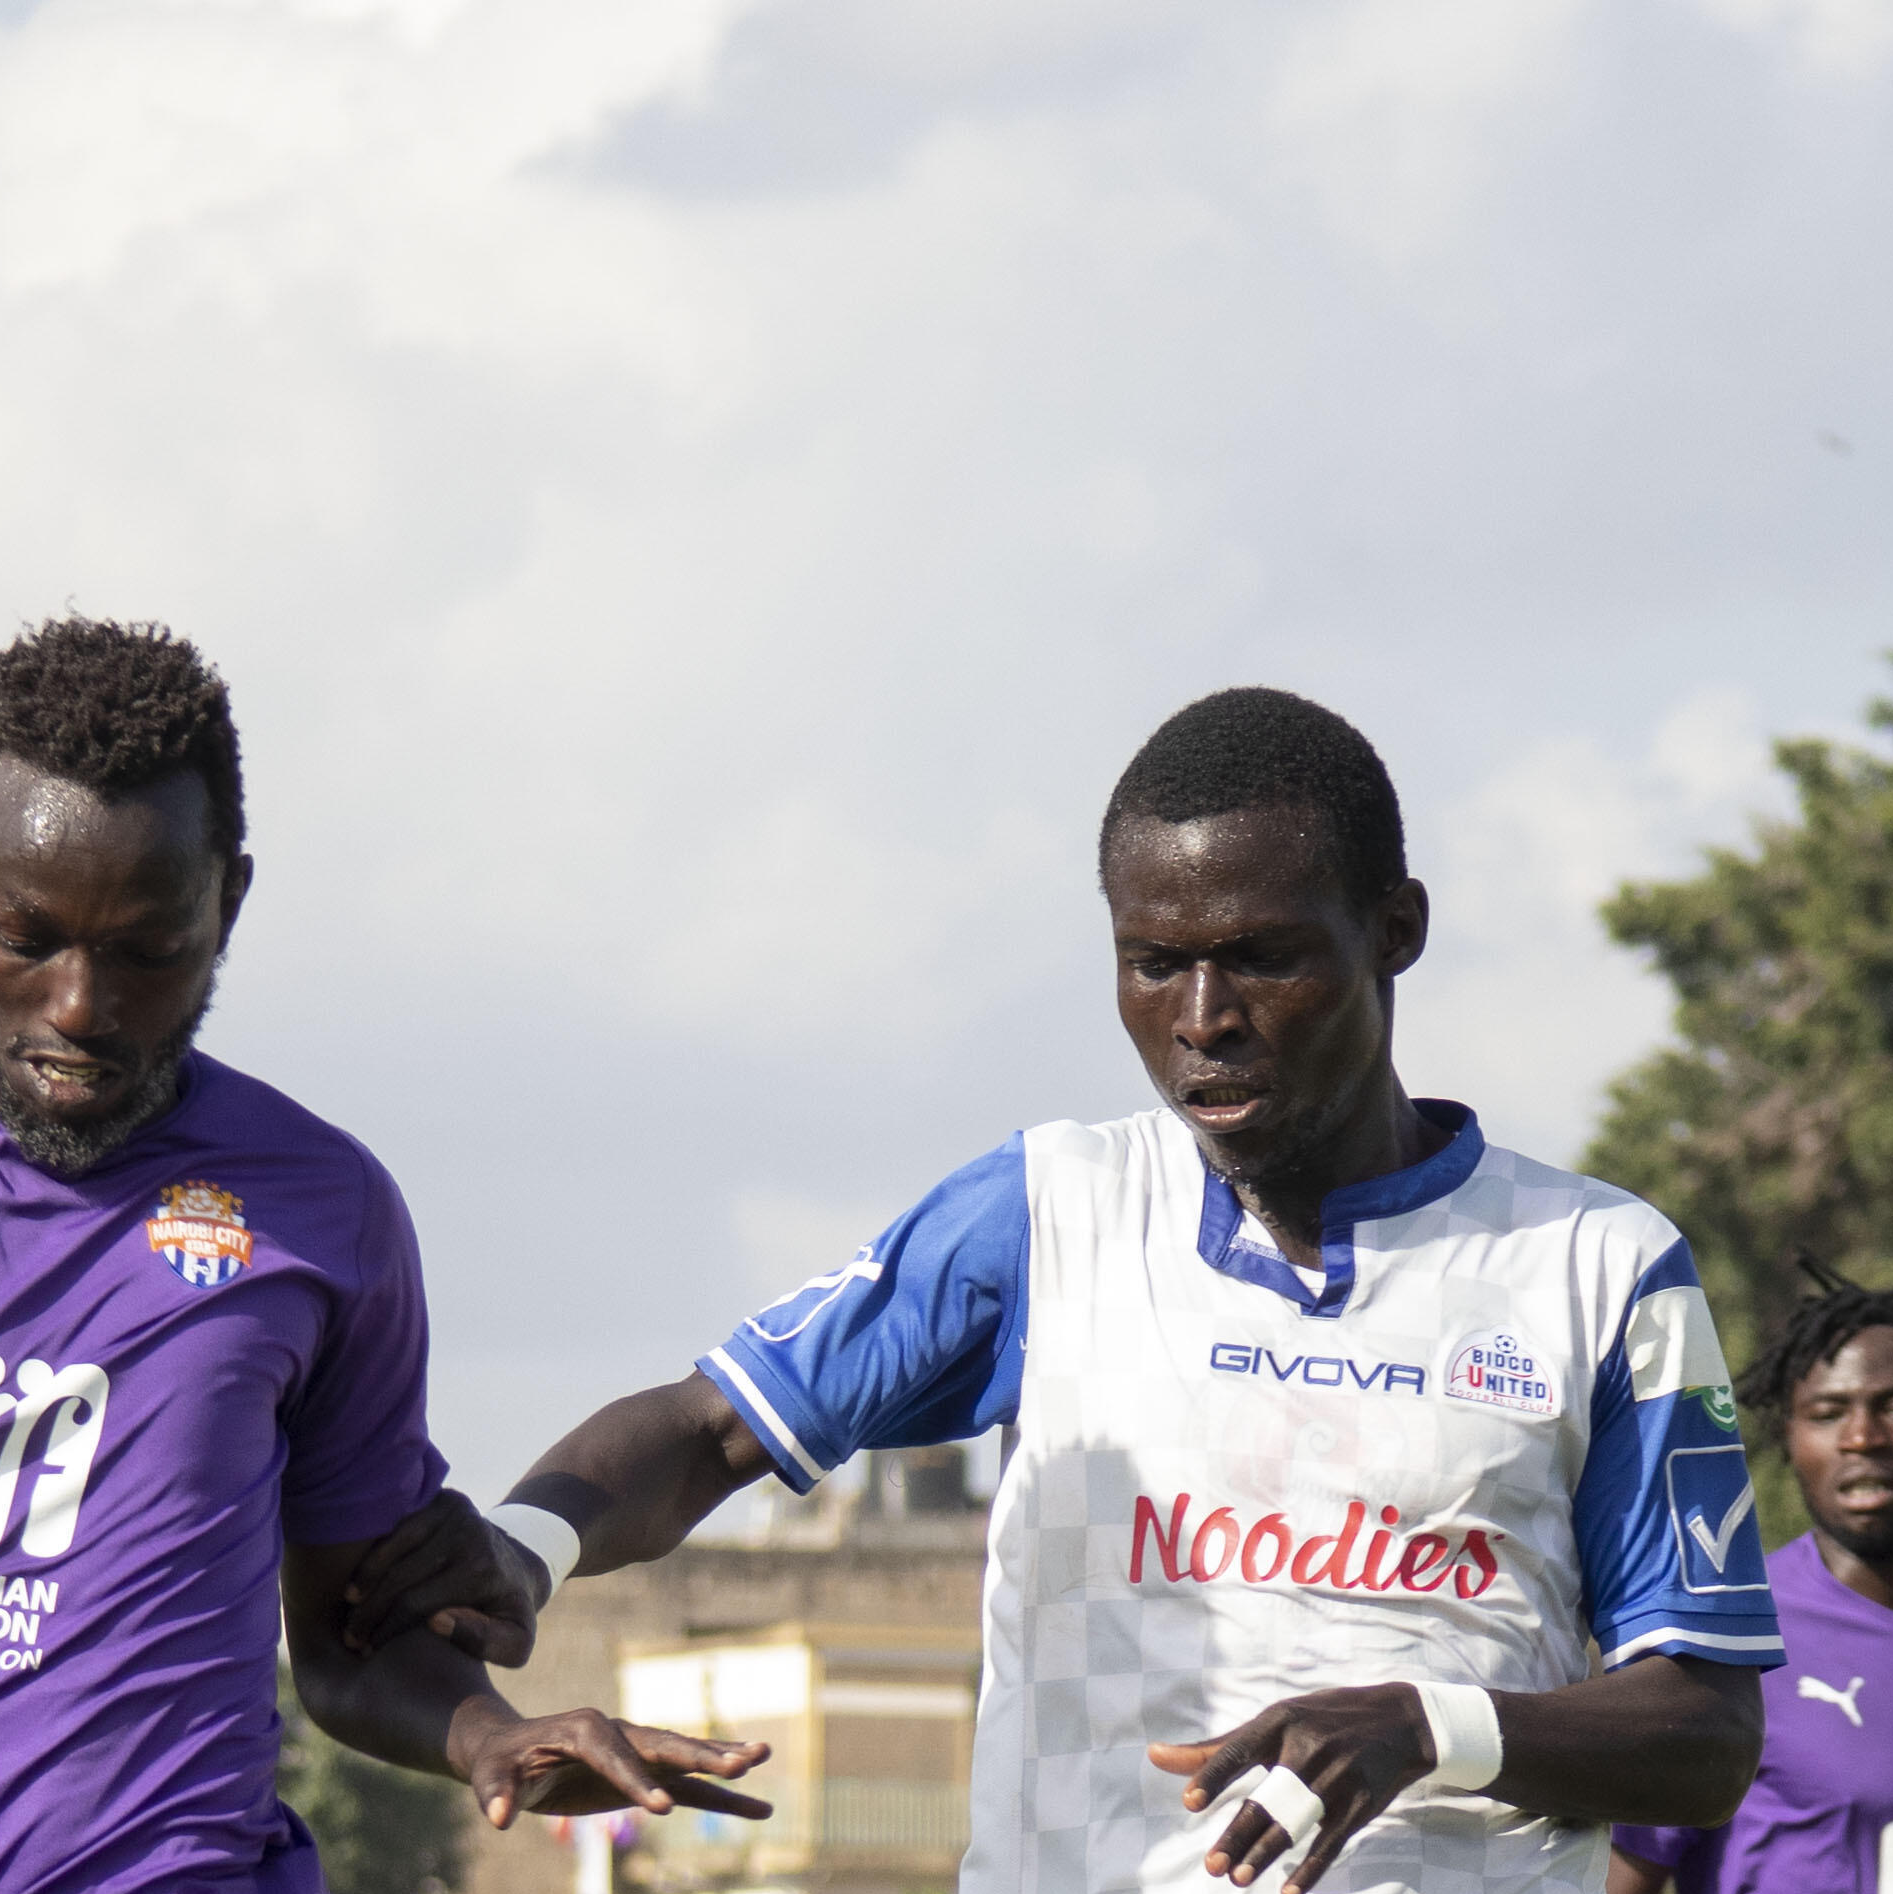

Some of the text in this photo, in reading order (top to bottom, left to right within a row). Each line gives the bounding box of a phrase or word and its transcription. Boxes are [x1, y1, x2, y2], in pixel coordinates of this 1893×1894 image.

[152, 1220, 251, 1254] NAIROBI CITY
[1211, 1342, 1425, 1396] GIVOVA
[1472, 1349, 1533, 1373] BIDCO
[1468, 1364, 1546, 1399] UNITED
[1129, 1492, 1505, 1600] Noodies
